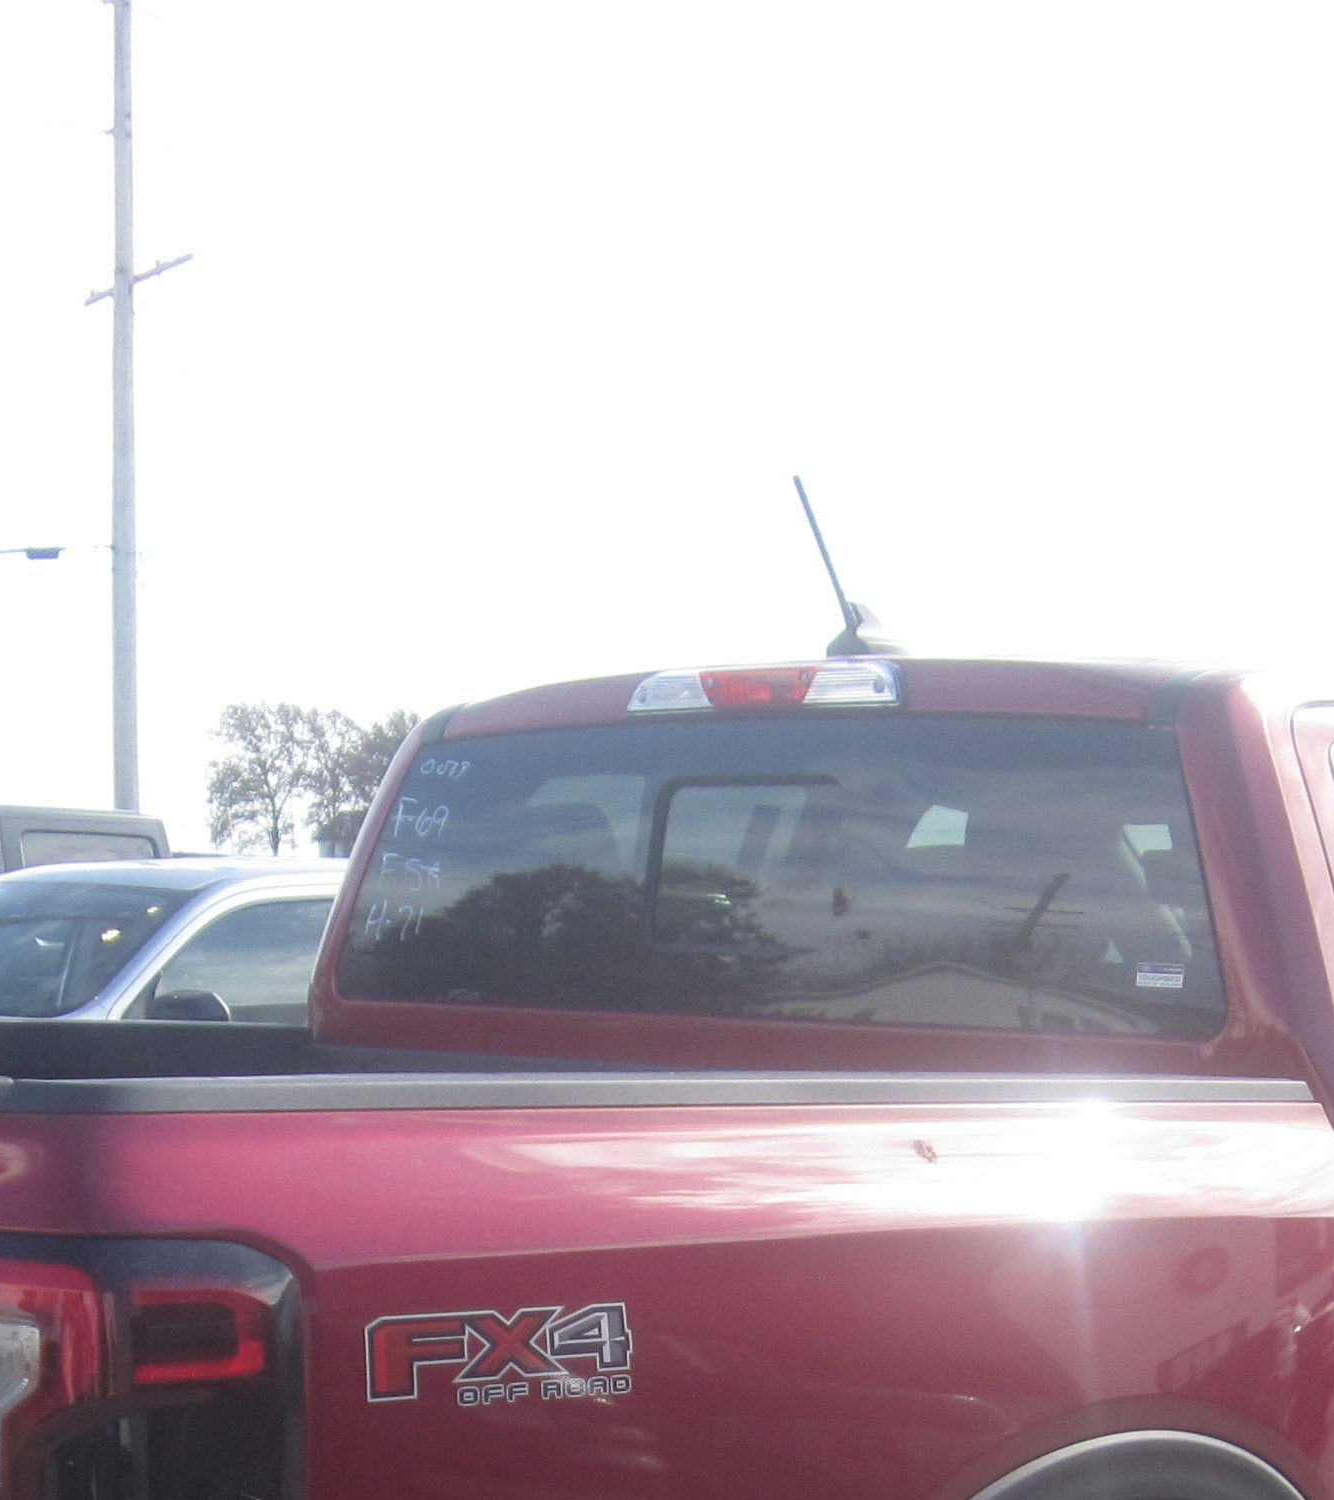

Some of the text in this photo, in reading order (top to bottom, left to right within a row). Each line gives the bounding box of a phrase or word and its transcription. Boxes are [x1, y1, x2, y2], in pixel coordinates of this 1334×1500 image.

[364, 1302, 633, 1403] FX4
[456, 1374, 632, 1407] OFF ROAD
